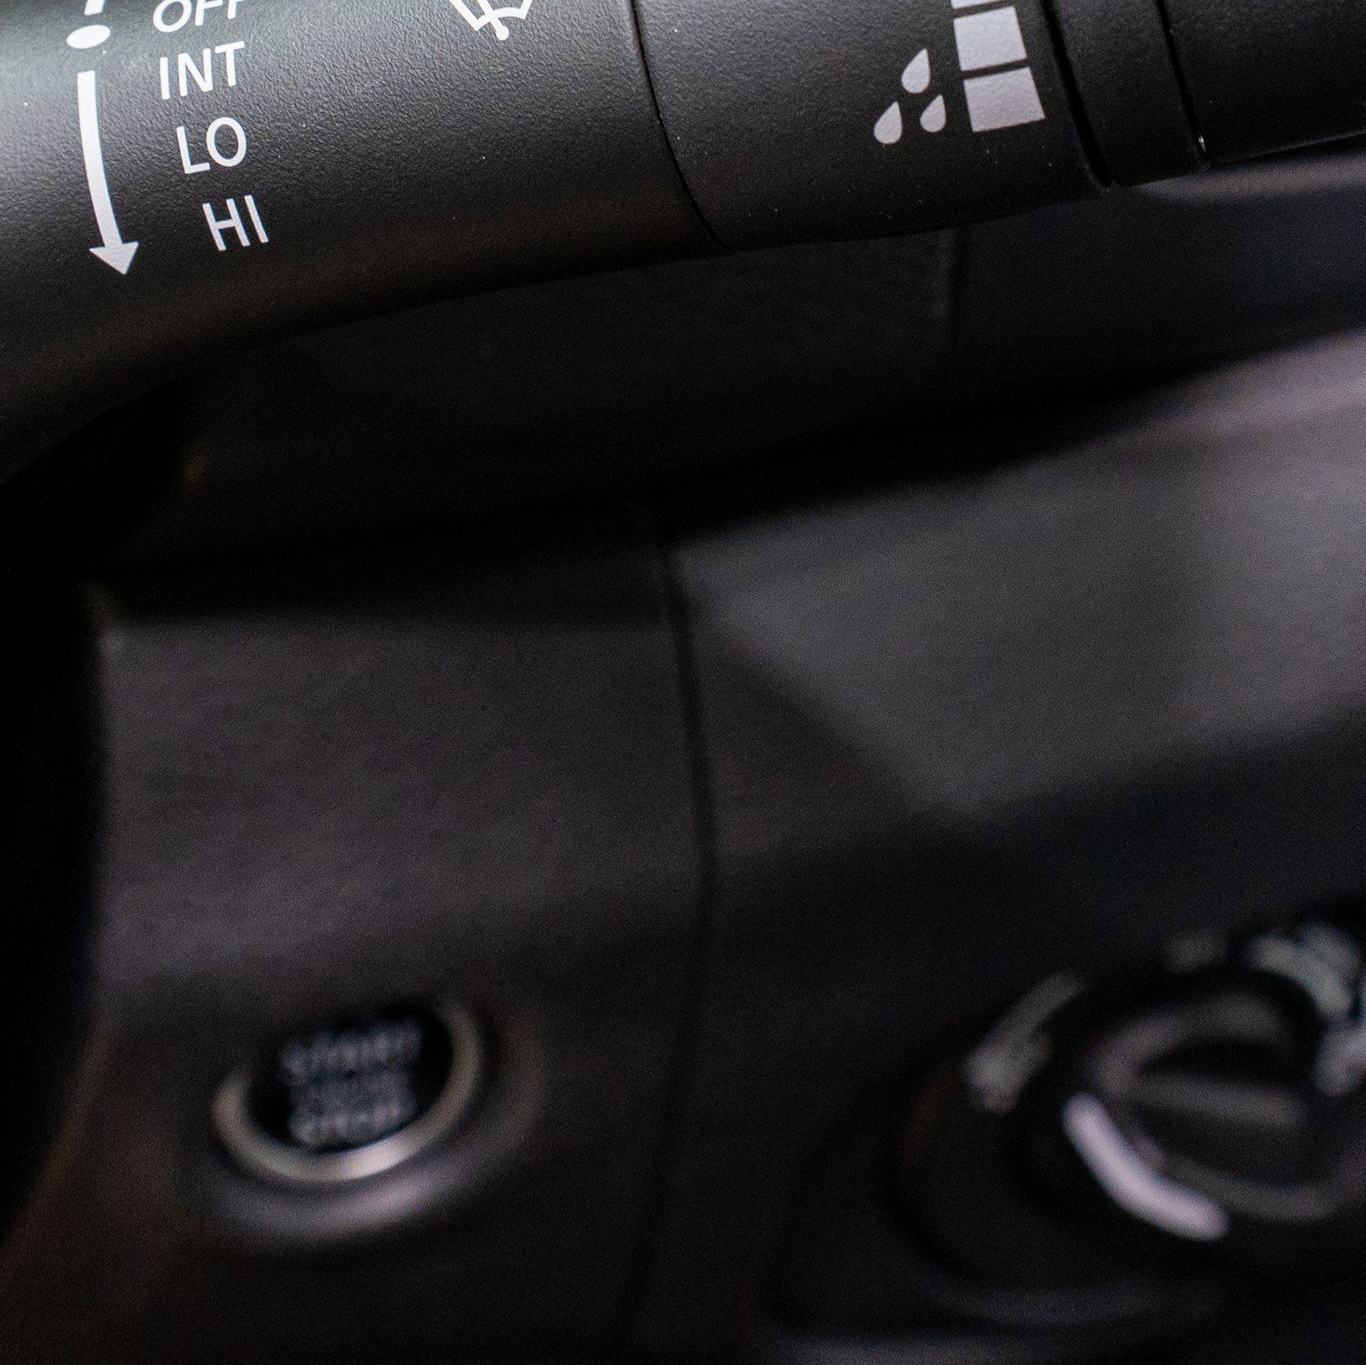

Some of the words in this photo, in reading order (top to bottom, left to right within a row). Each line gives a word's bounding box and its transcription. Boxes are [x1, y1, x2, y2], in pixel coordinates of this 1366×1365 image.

[159, 41, 245, 100] INT
[176, 116, 247, 174] LO
[202, 194, 269, 251] HI
